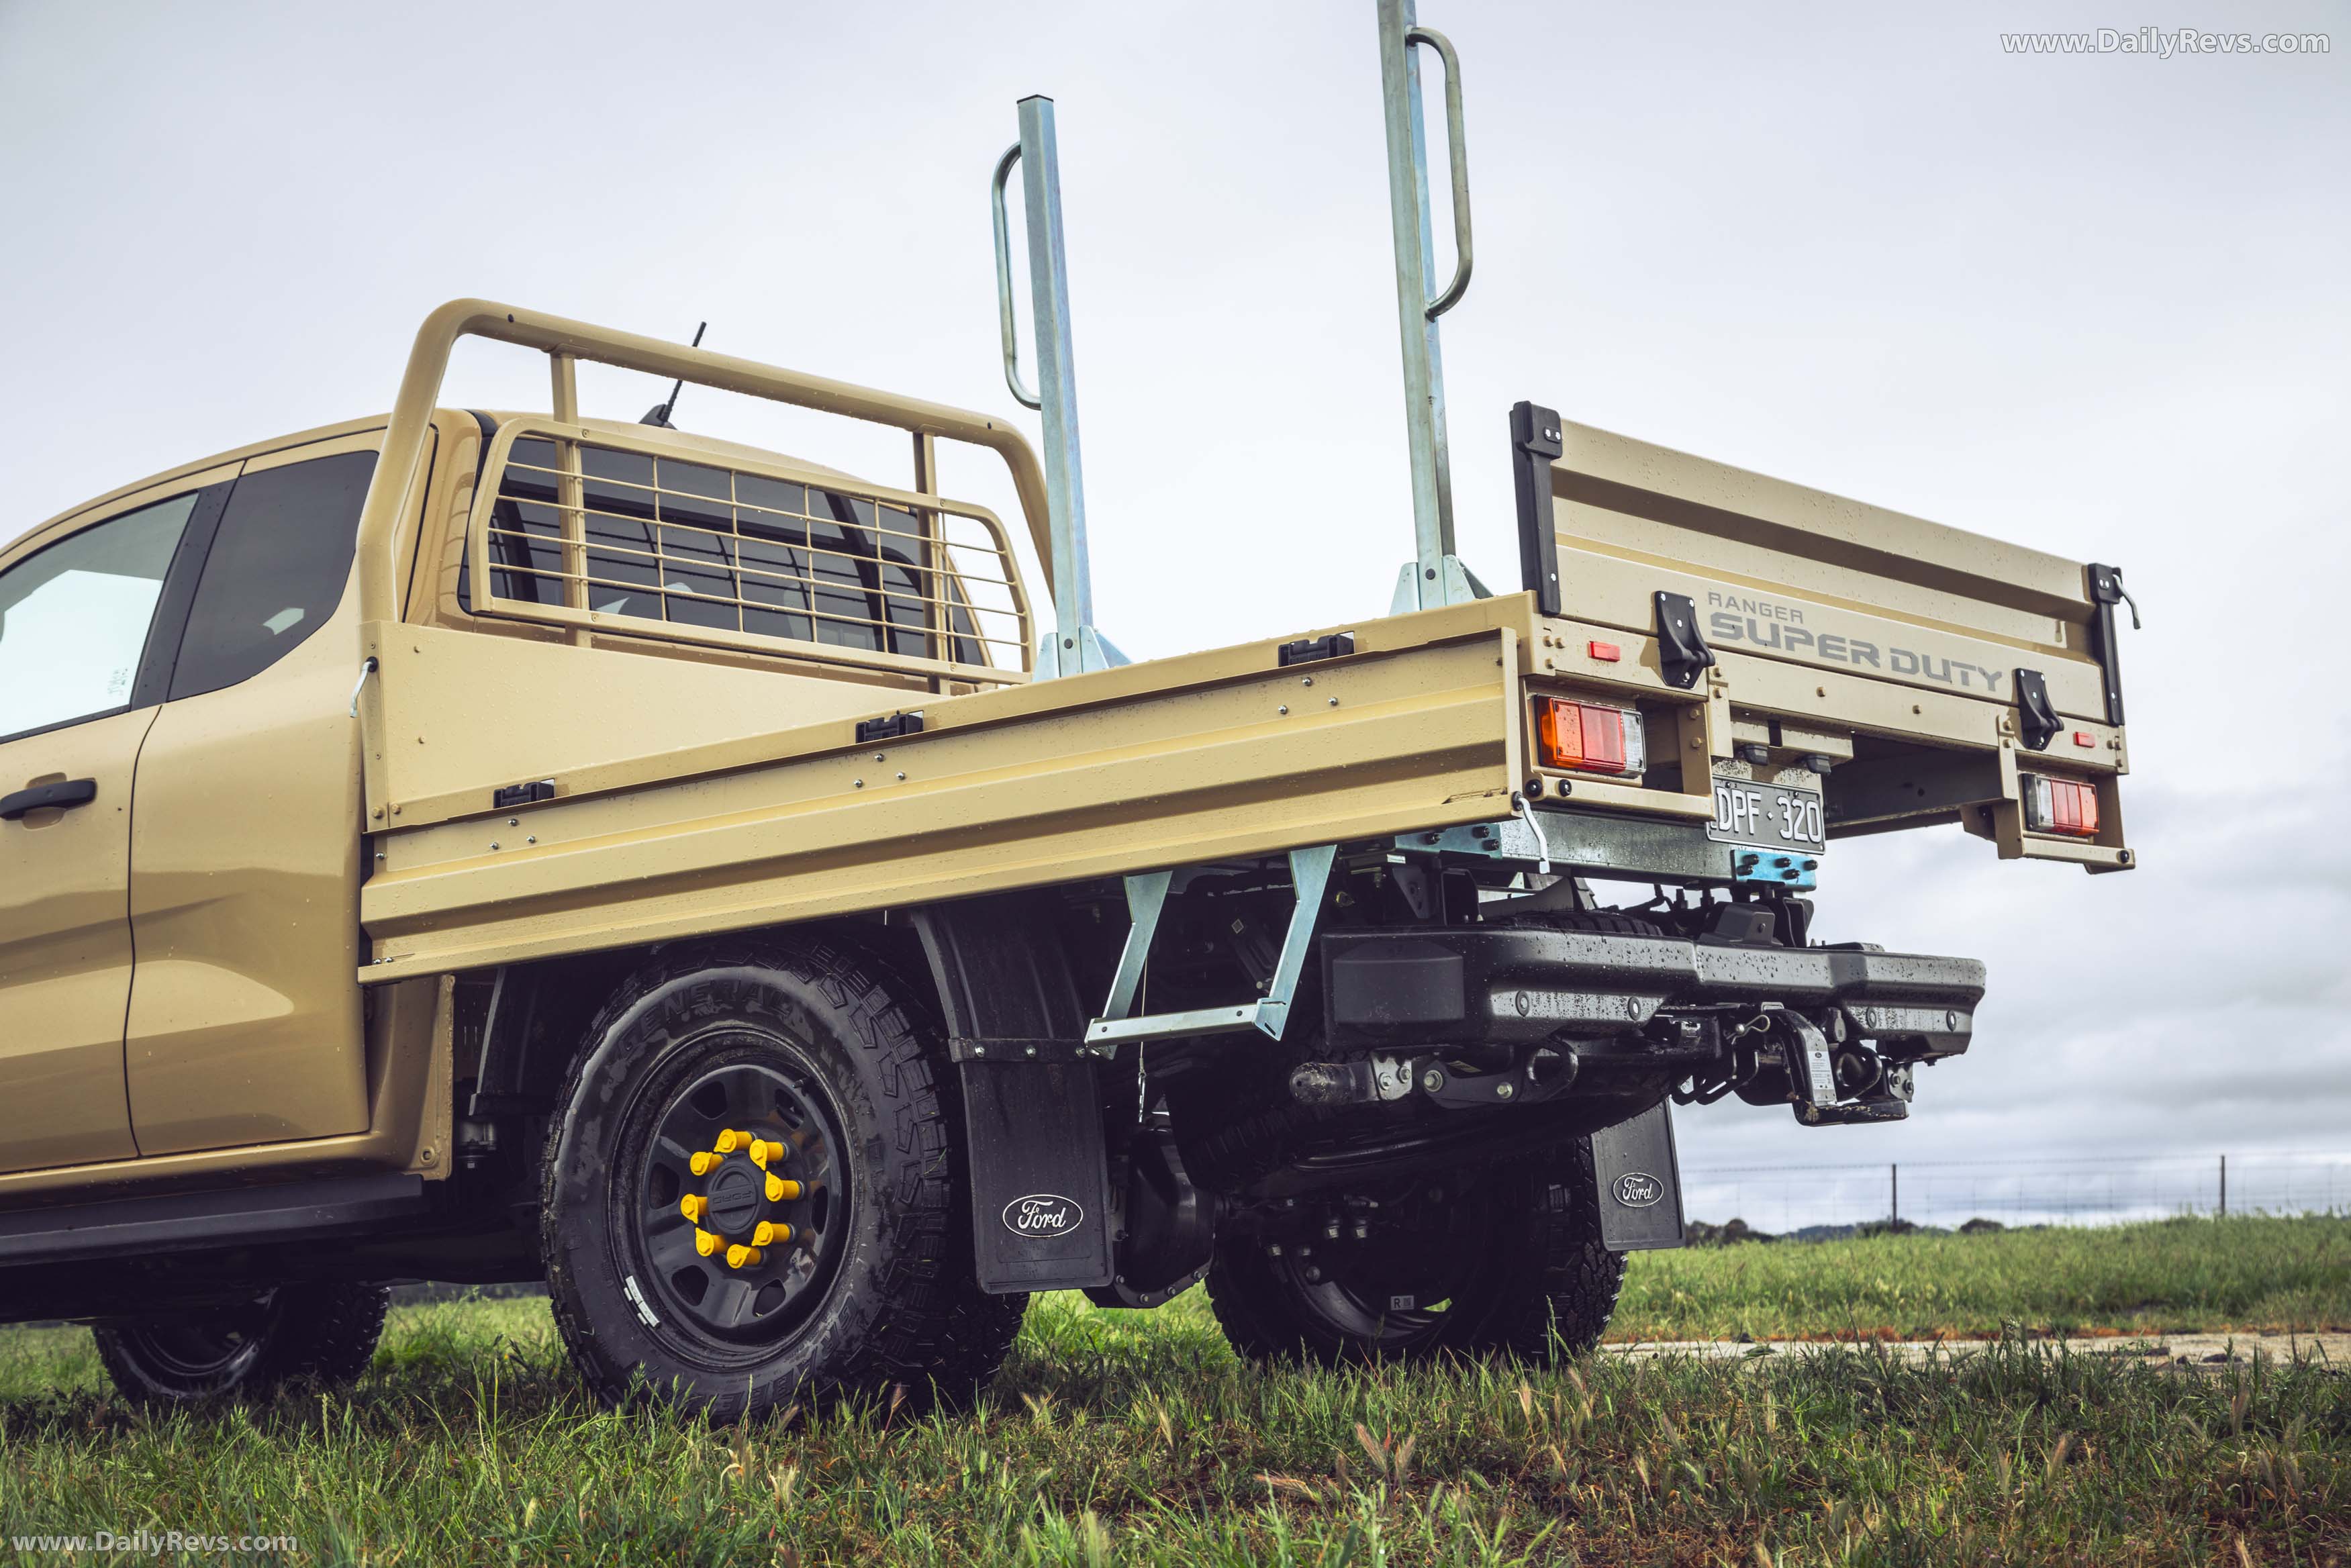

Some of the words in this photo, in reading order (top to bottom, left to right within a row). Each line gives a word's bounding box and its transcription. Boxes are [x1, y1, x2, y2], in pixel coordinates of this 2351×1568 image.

[1708, 591, 1804, 625] RANGER
[1711, 611, 1880, 669] SUPER
[1890, 647, 2003, 693] DUTY
[1622, 1177, 1653, 1200] Ford
[1017, 1200, 1067, 1229] Ford
[1394, 1297, 1401, 1309] R
